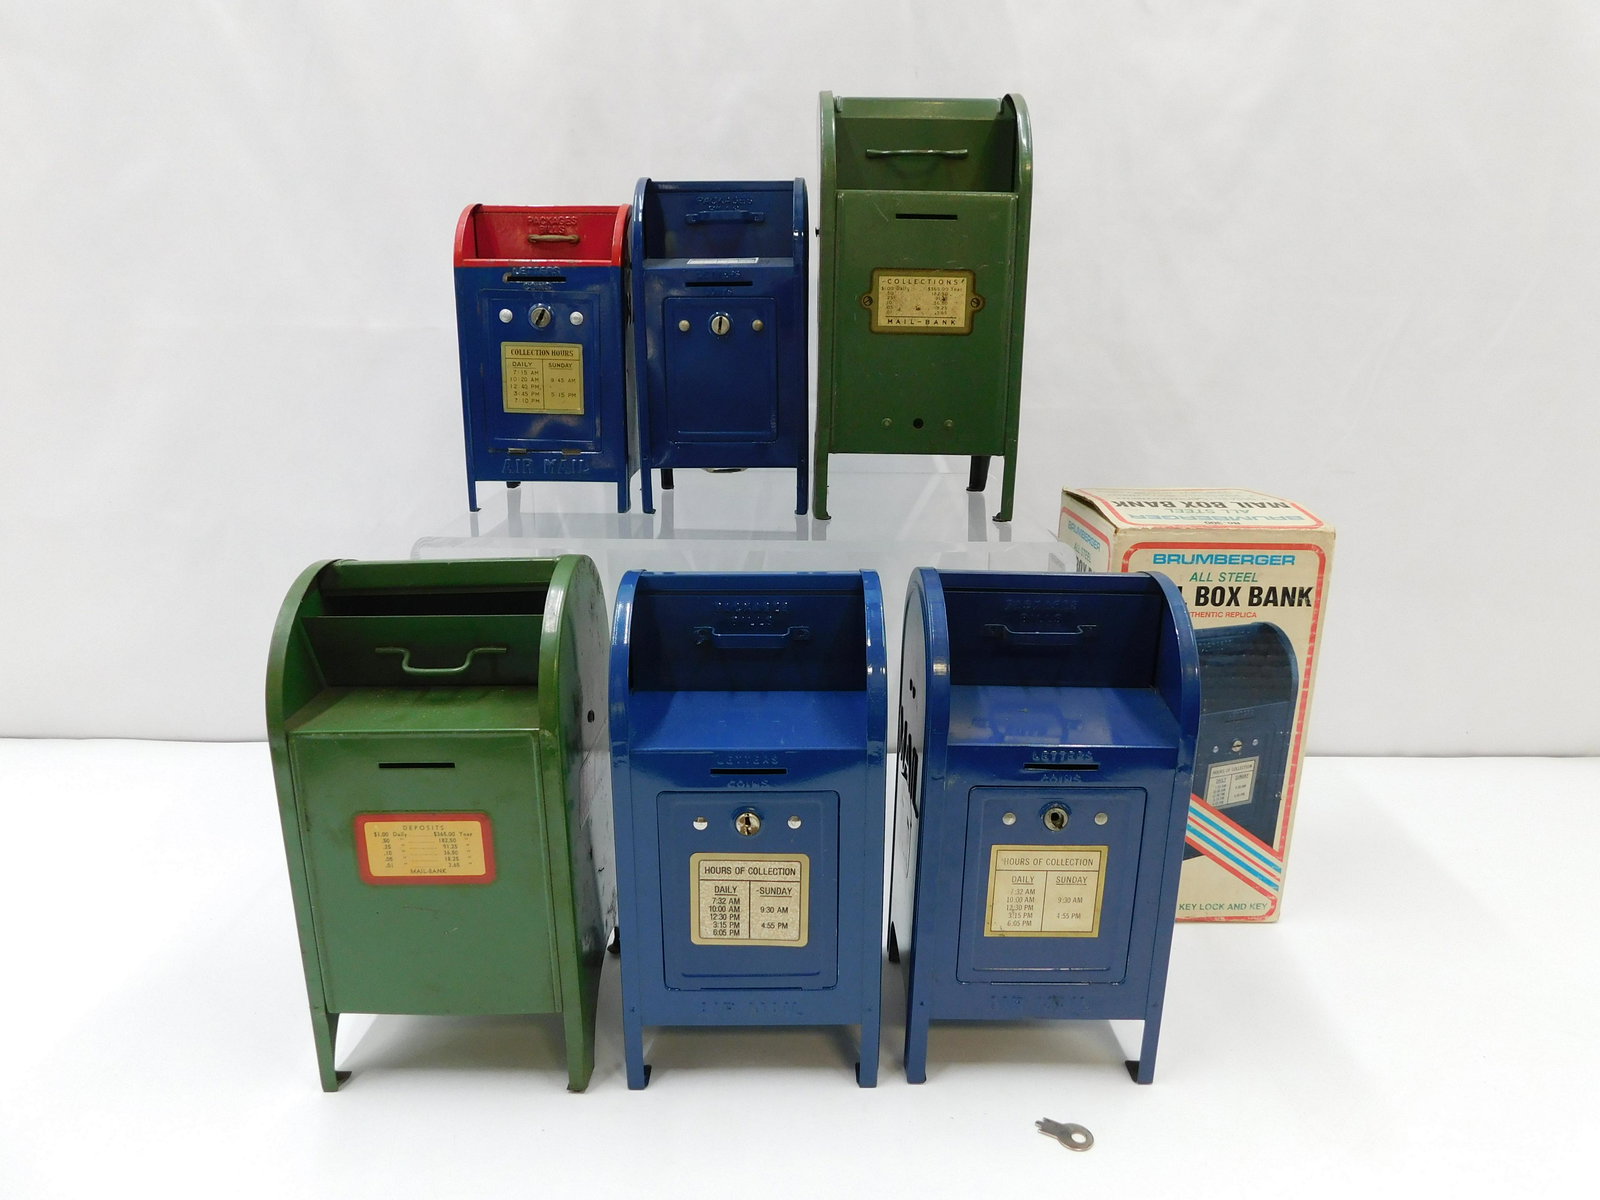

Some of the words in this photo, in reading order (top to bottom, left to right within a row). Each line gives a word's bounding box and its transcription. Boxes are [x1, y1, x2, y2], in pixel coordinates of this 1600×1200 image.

[527, 215, 578, 225] PACKAGES
[510, 348, 550, 356] COLLECTION
[551, 349, 574, 357] HOURS
[501, 458, 534, 474] AIR
[543, 458, 590, 474] MAIL
[1111, 500, 1177, 508] BANK
[1153, 553, 1296, 566] BRUMBERGER
[1189, 571, 1214, 582] ALL
[1218, 571, 1259, 583] STEEL
[1194, 585, 1242, 607] BOX
[1247, 585, 1314, 608] BANK
[1003, 857, 1030, 866] HOURS
[1032, 857, 1043, 866] OF
[1045, 858, 1094, 867] COLLECTION
[704, 866, 732, 875] HOURS
[734, 866, 745, 875] OF
[747, 867, 796, 876] COLLECTION
[1011, 875, 1035, 884] DAILY
[1055, 876, 1089, 885] SUNDAY
[714, 885, 738, 894] DAILY
[1024, 888, 1036, 896] AM
[712, 897, 727, 905] 7:32
[728, 897, 740, 905] AM
[1006, 896, 1023, 904] 10:00
[1024, 896, 1036, 904] AM
[1057, 896, 1072, 904] 9:30
[1072, 896, 1084, 904] AM
[709, 905, 727, 913] 10:00
[728, 905, 740, 913] AM
[760, 906, 775, 914] 9:30
[776, 906, 789, 914] AM
[1006, 904, 1023, 912] 12:30
[1023, 904, 1034, 912] PM
[1178, 903, 1197, 911] KEY
[1199, 903, 1225, 911] LOCK
[1226, 903, 1247, 911] AND
[1249, 902, 1269, 910] KEY
[709, 913, 728, 921] 12:30
[729, 913, 740, 921] PM
[1008, 912, 1022, 920] 3:15
[1022, 912, 1034, 920] PM
[1070, 912, 1082, 920] PM
[712, 921, 727, 929] 3:15
[729, 921, 740, 929] PM
[1007, 920, 1021, 928] 6:05
[1021, 920, 1033, 928] PM
[712, 929, 727, 937] 6:05
[729, 929, 740, 937] PM
